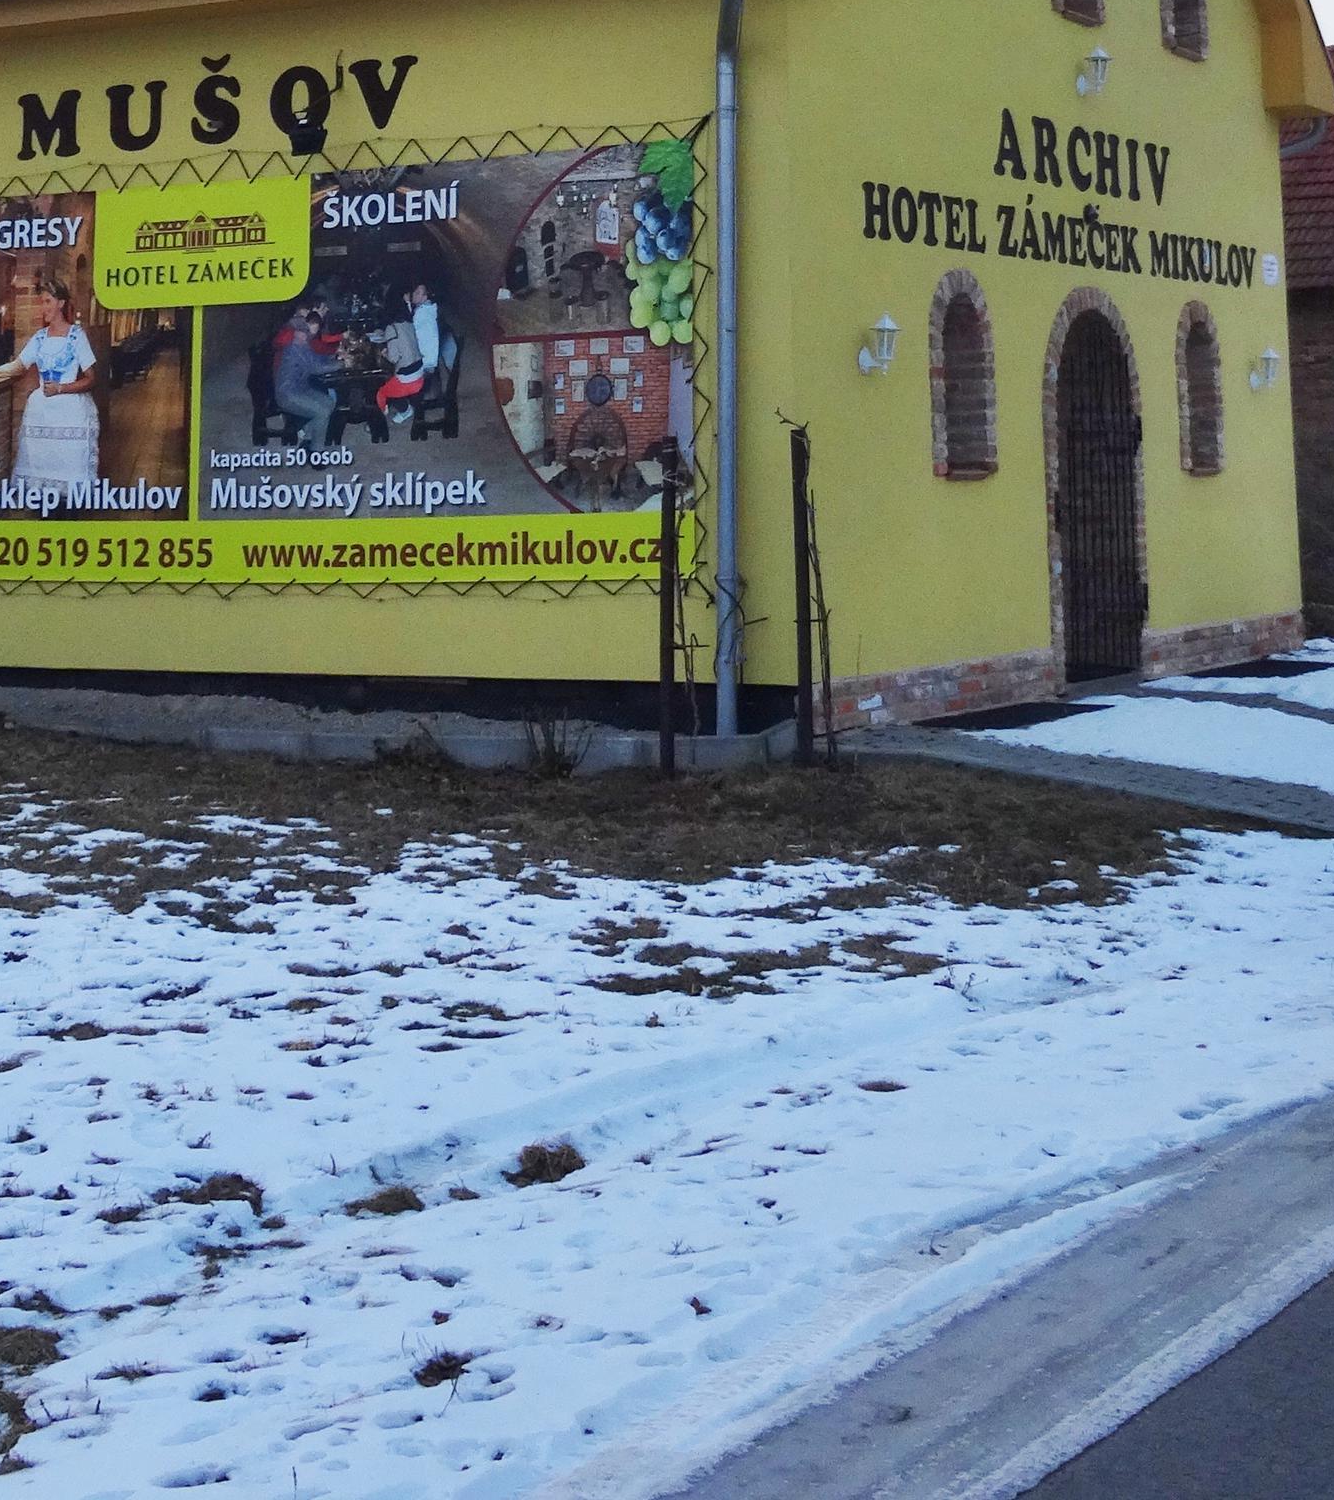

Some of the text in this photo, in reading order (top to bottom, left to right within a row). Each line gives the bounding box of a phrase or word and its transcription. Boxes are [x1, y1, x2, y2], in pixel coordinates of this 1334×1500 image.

[17, 53, 418, 160] MUŠOV
[993, 108, 1170, 206] ARCHIV
[322, 180, 460, 229] ŠKOLENÍ
[862, 181, 1257, 289] HOTEL ZÁMEČEK MIKULOV
[106, 256, 295, 288] HOTEL ZÁMEČEK
[210, 446, 353, 471] kapacita 50 osob
[66, 477, 182, 510] Mikulov
[210, 470, 486, 517] Mušovský sklípek
[36, 537, 89, 567] 519
[97, 538, 150, 568] 512
[158, 538, 213, 568] 855
[242, 529, 664, 568] www.zamecekmikulov.cz
